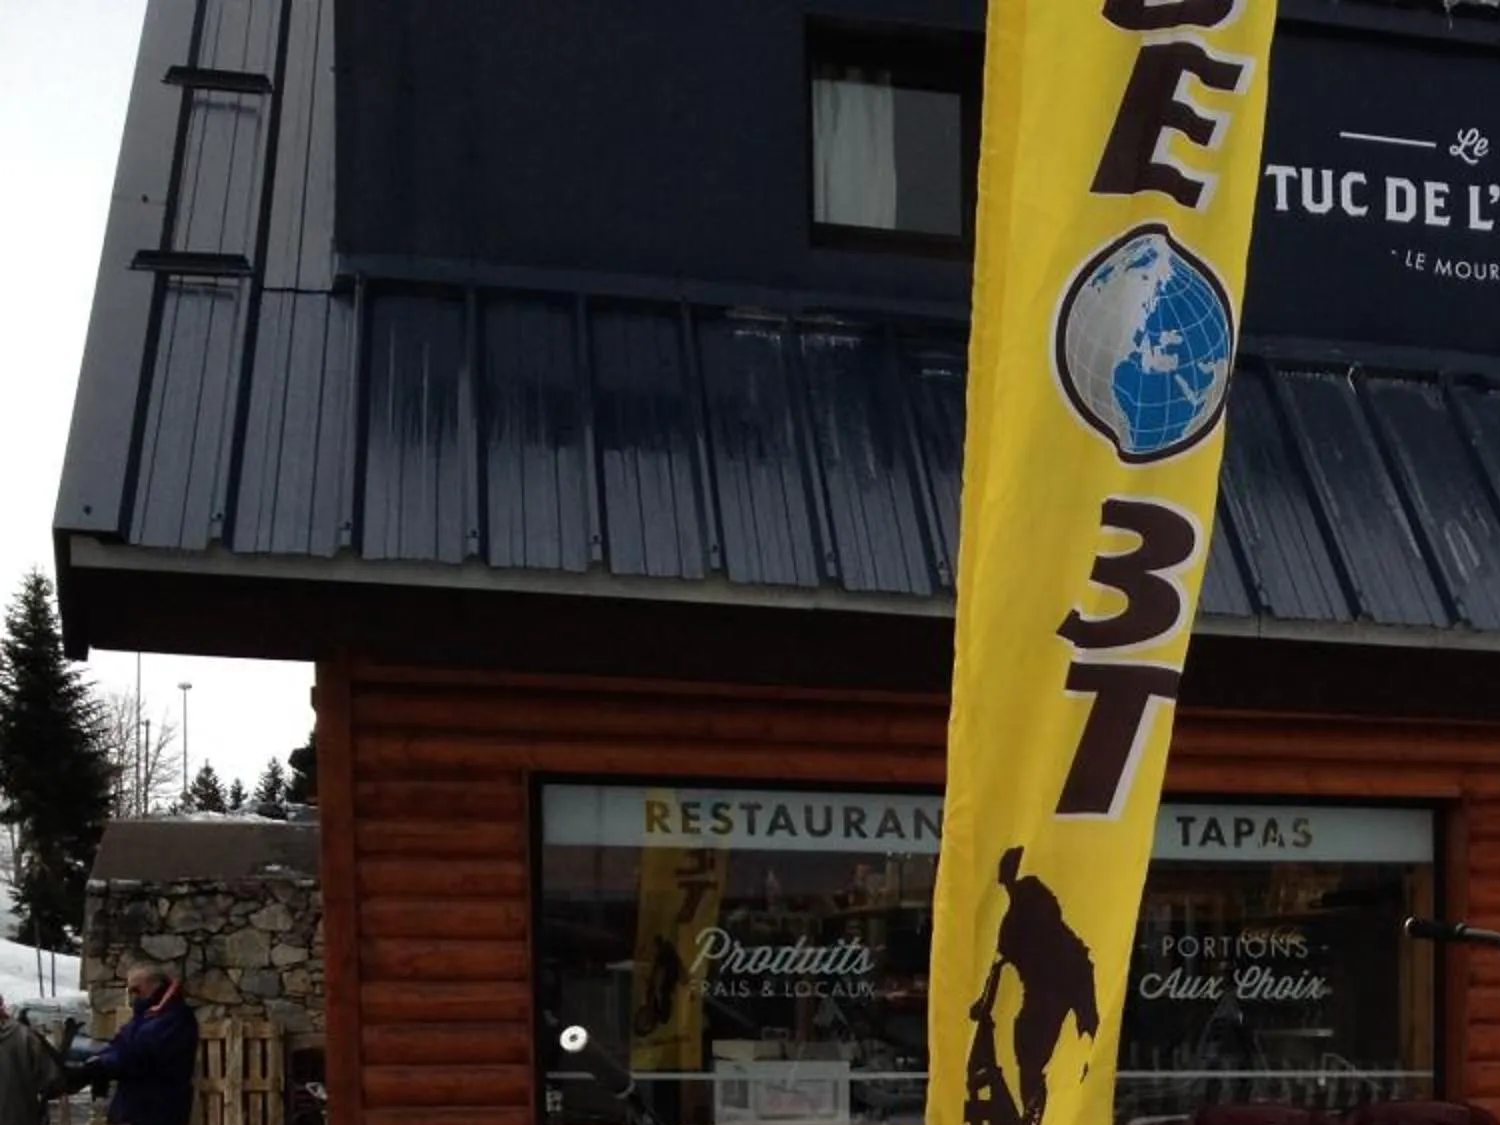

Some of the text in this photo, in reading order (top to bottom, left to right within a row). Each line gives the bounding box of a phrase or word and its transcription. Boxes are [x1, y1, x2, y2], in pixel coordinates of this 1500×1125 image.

[1449, 128, 1490, 165] Le
[1265, 164, 1368, 217] TUC
[1386, 176, 1451, 228] DE
[1405, 250, 1426, 271] LE
[1176, 816, 1314, 849] TAPAS
[688, 926, 875, 975] Produits
[1162, 935, 1309, 959] PORTIONS
[762, 980, 775, 998] &
[785, 980, 875, 1000] LOCAUX
[1140, 965, 1332, 1001] Aux Choix
